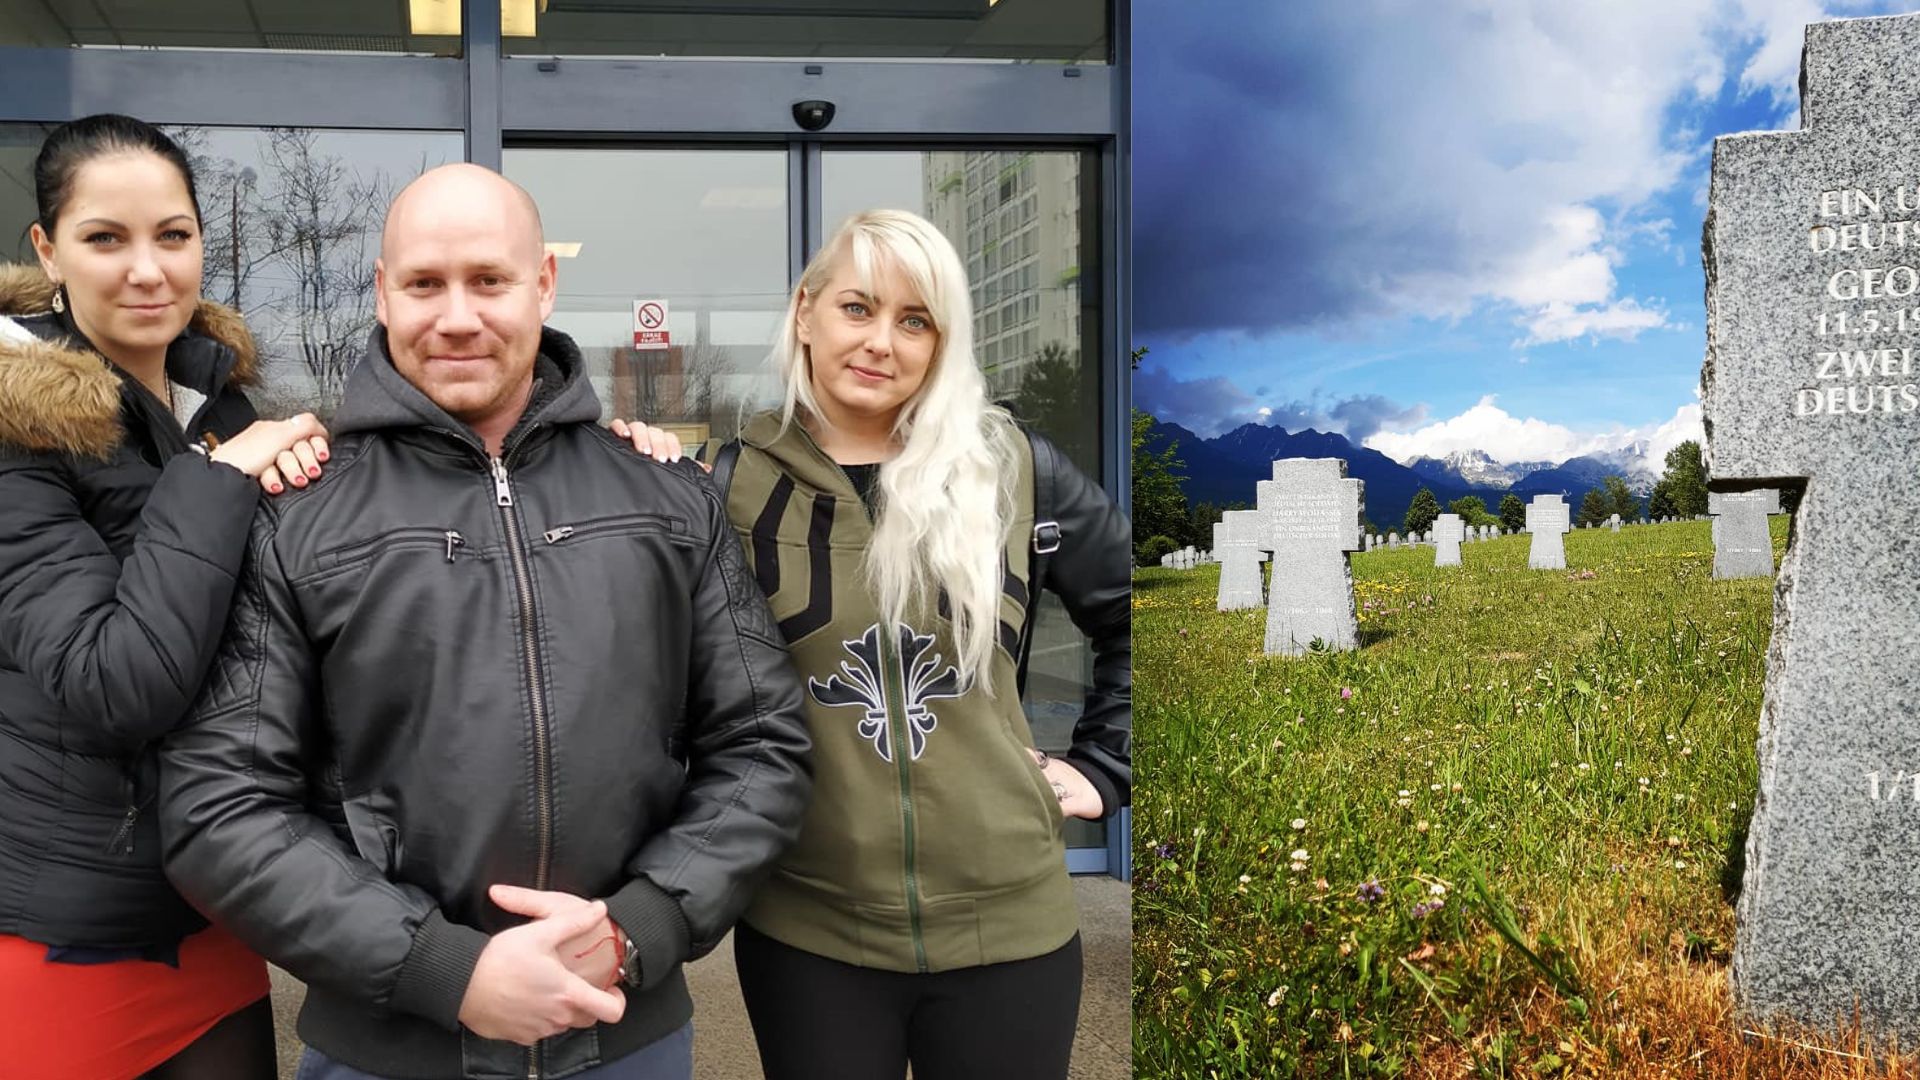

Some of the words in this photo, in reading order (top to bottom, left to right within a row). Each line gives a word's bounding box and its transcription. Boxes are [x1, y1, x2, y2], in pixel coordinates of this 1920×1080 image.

[1822, 187, 1880, 217] EIN
[1827, 266, 1919, 300] GEO
[1816, 348, 1913, 379] ZWEI
[1797, 383, 1919, 416] DEUTS
